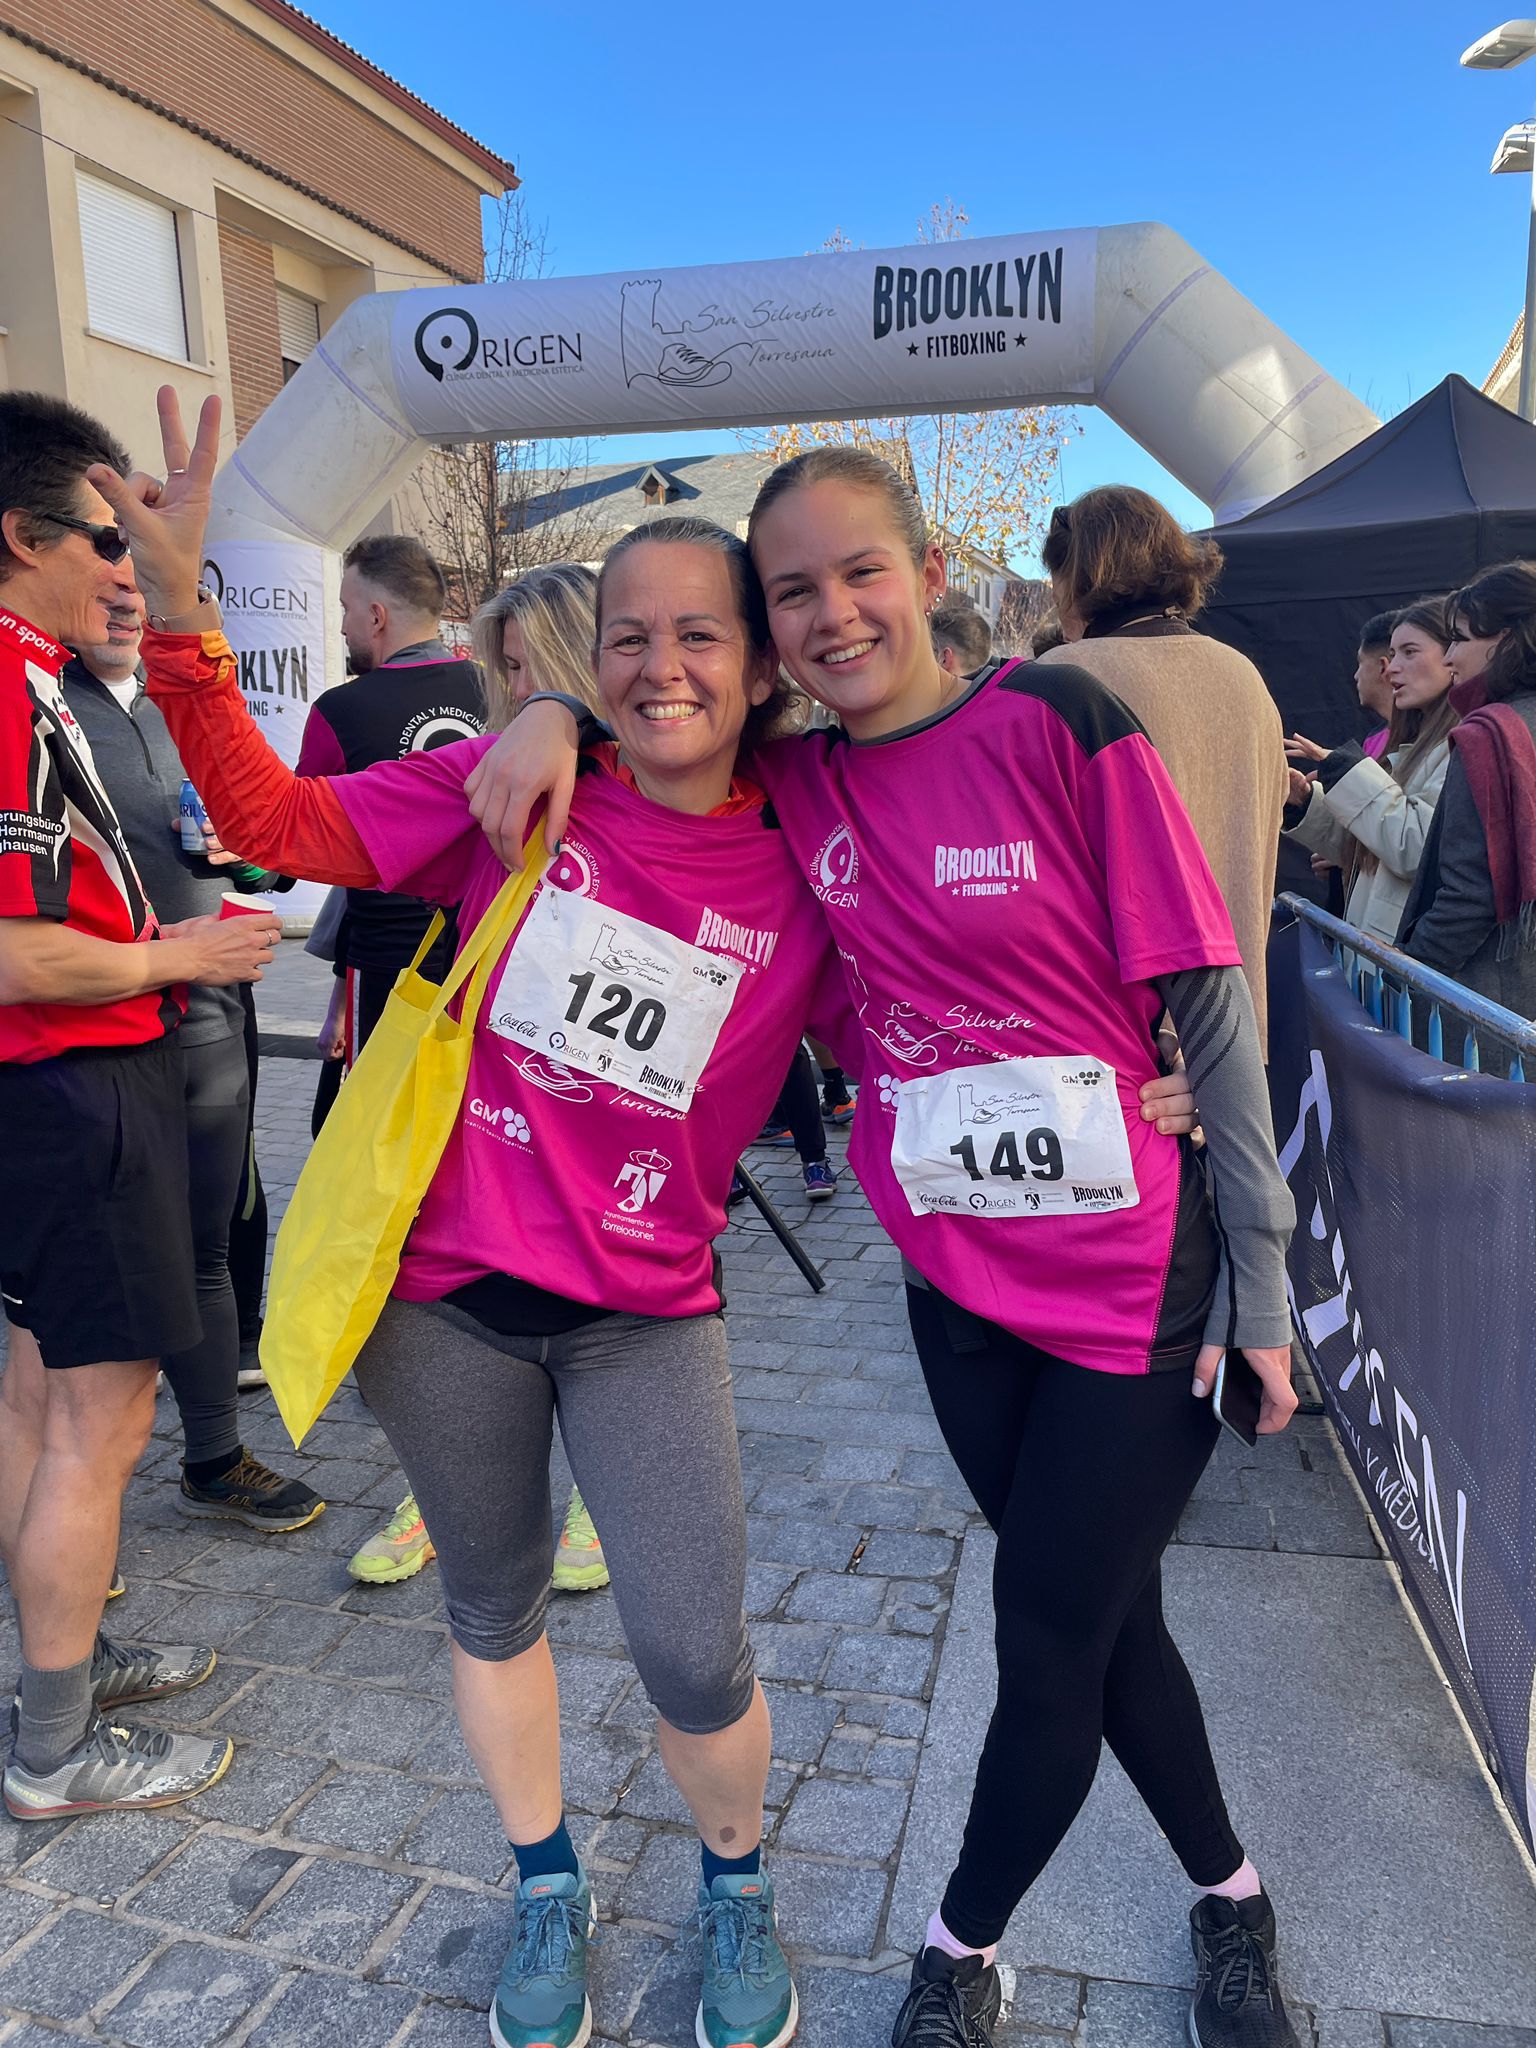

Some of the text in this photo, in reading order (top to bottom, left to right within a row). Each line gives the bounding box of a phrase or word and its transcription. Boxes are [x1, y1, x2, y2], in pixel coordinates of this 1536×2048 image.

[873, 247, 1064, 340] BROOKLYN
[689, 300, 837, 333] San Silvestre
[414, 307, 583, 383] ORIGEN
[748, 338, 836, 367] Torresana
[927, 330, 1007, 358] FITBOXING
[445, 364, 585, 382] CLÍNICA DENTAL Y MEDICINA ESTÉTICA
[16, 625, 59, 658] sports
[399, 711, 430, 746] DENTAL
[428, 703, 436, 717] Y
[0, 824, 54, 845] Herrmann
[570, 840, 600, 877] MEDICINA
[809, 847, 826, 876] CLÍNICA
[935, 839, 1038, 888] BROOKLYN
[962, 882, 1008, 897] FITBOXING
[694, 905, 779, 971] BROOKLYN
[692, 966, 709, 979] GM
[564, 971, 667, 1052] 120
[937, 1004, 1036, 1031] Silvestre
[549, 1031, 591, 1061] ORIGEN
[638, 1064, 686, 1096] BROOKLYN
[1061, 1075, 1079, 1085] GM
[469, 1098, 501, 1126] GM
[950, 1126, 1064, 1182] 149
[968, 1192, 1017, 1210] ORIGEN
[1071, 1184, 1124, 1204] BROOKLYN
[600, 1218, 655, 1242] Torrelodones
[603, 1210, 655, 1230] Ayuntamiento de
